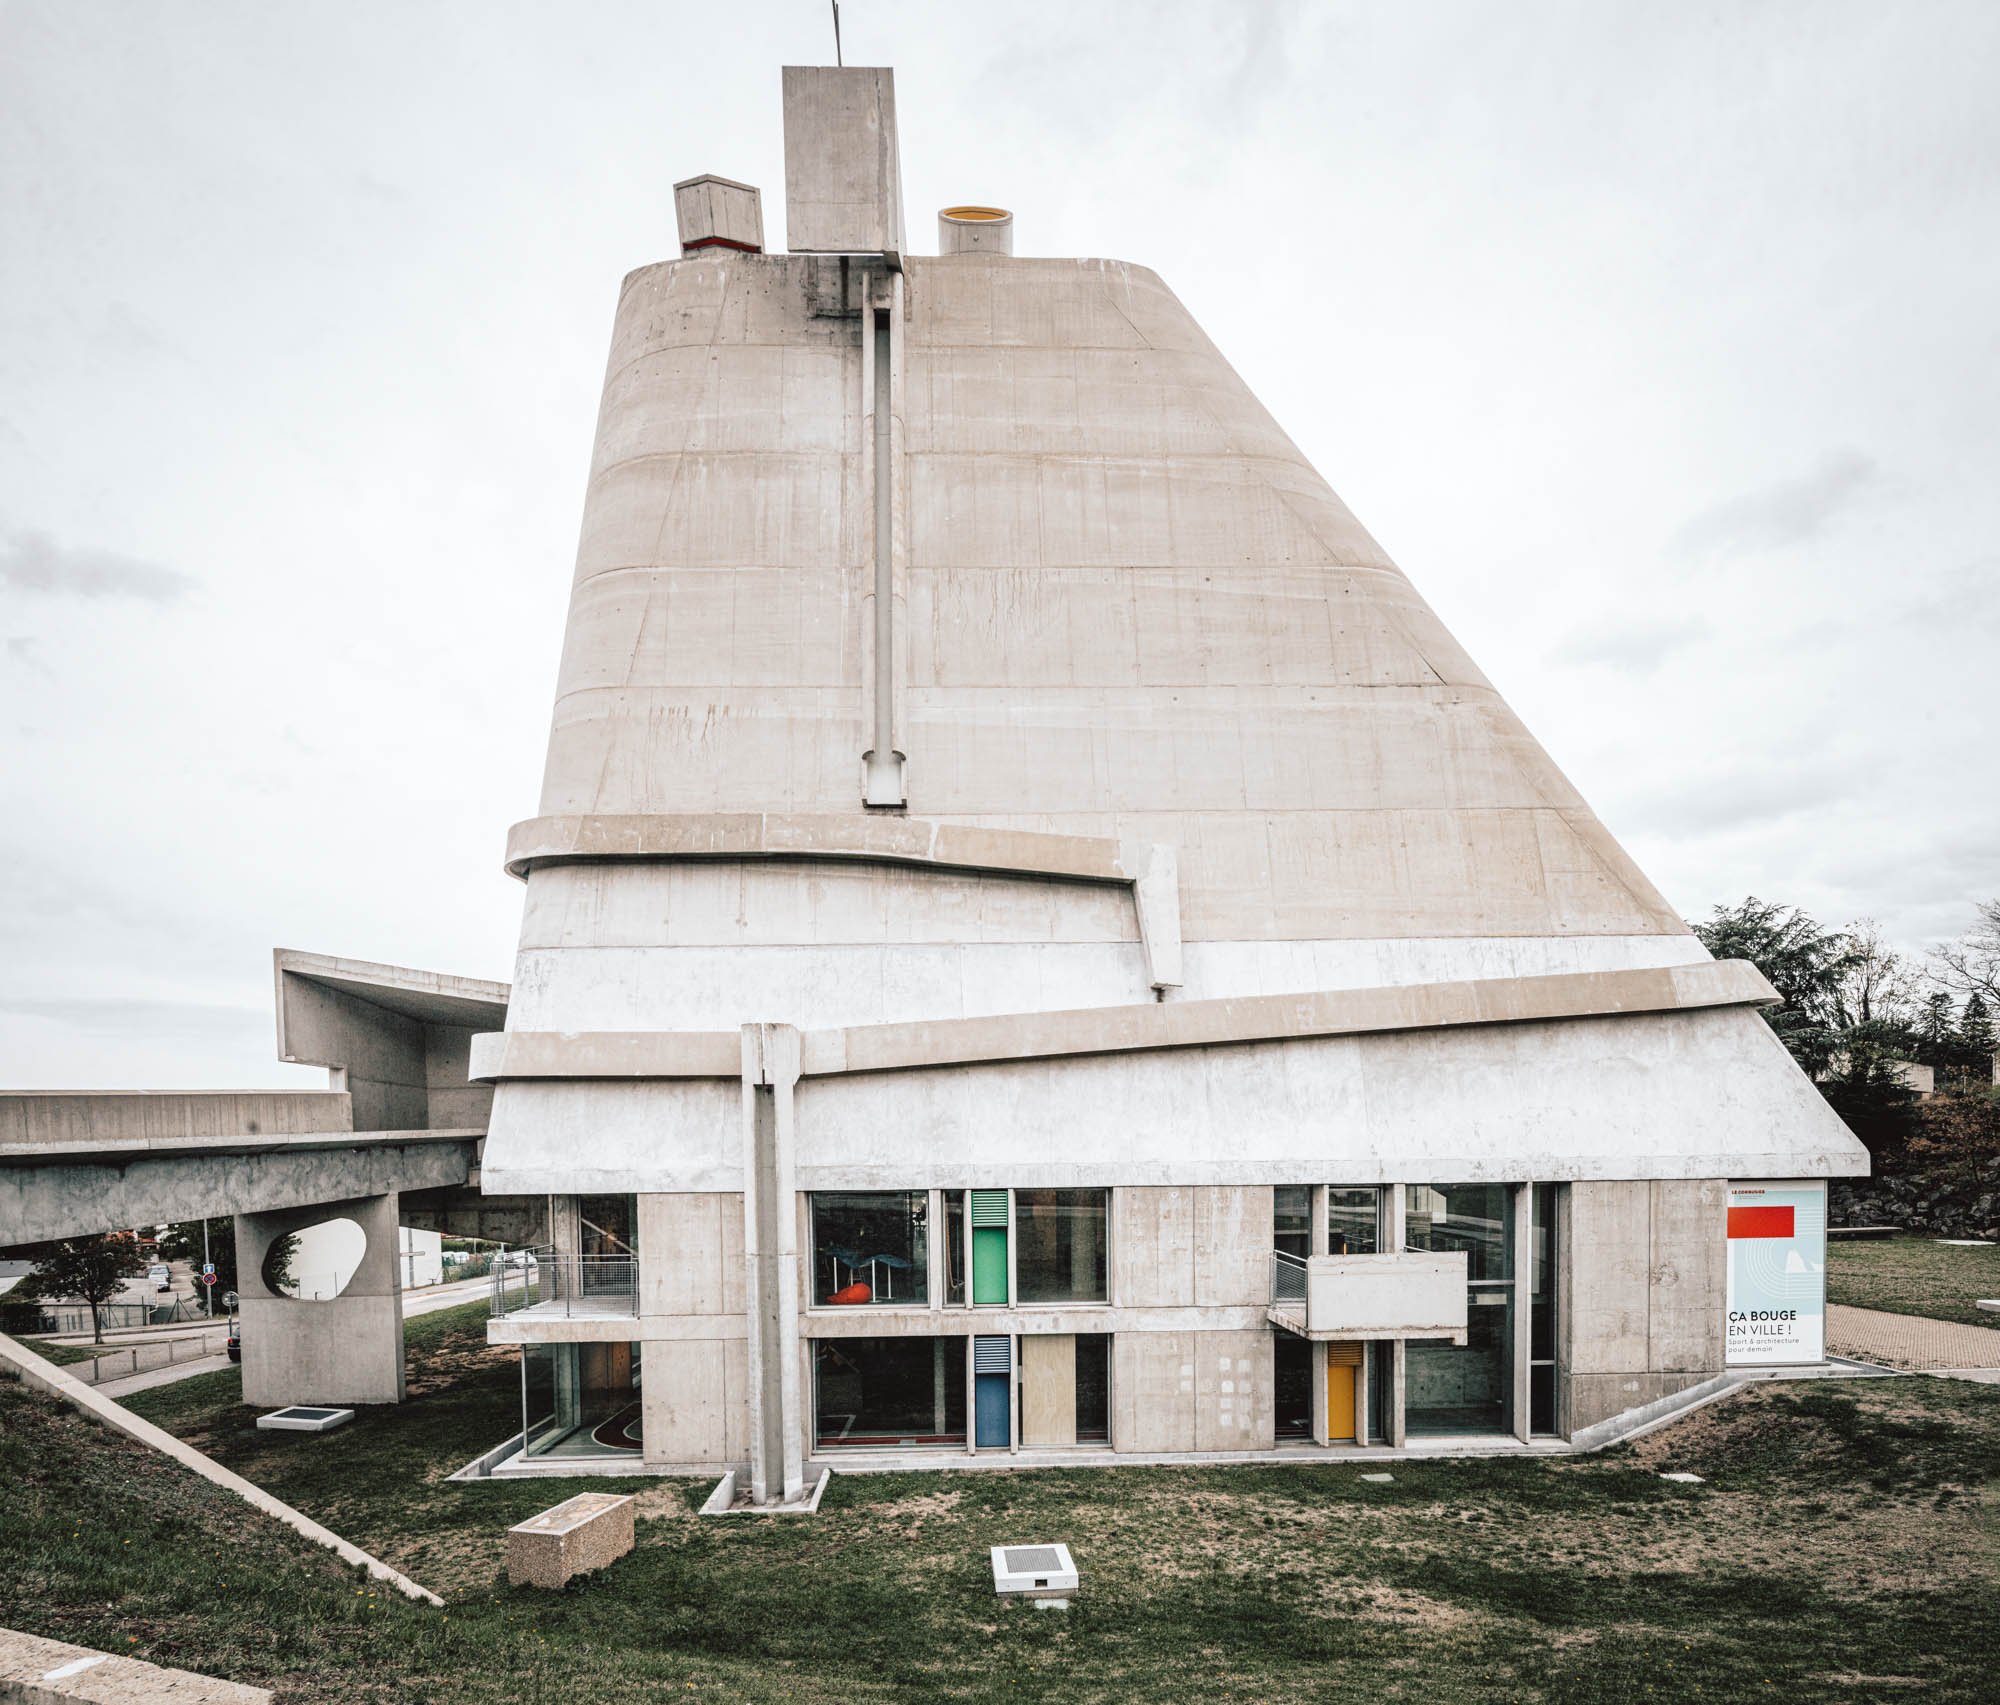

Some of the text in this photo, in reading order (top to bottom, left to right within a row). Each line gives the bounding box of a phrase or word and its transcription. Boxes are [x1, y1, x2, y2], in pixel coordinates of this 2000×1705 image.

[1729, 1310, 1797, 1324] ÇA BOUGE
[1729, 1325, 1746, 1336] EN
[1750, 1324, 1784, 1336] VILLE
